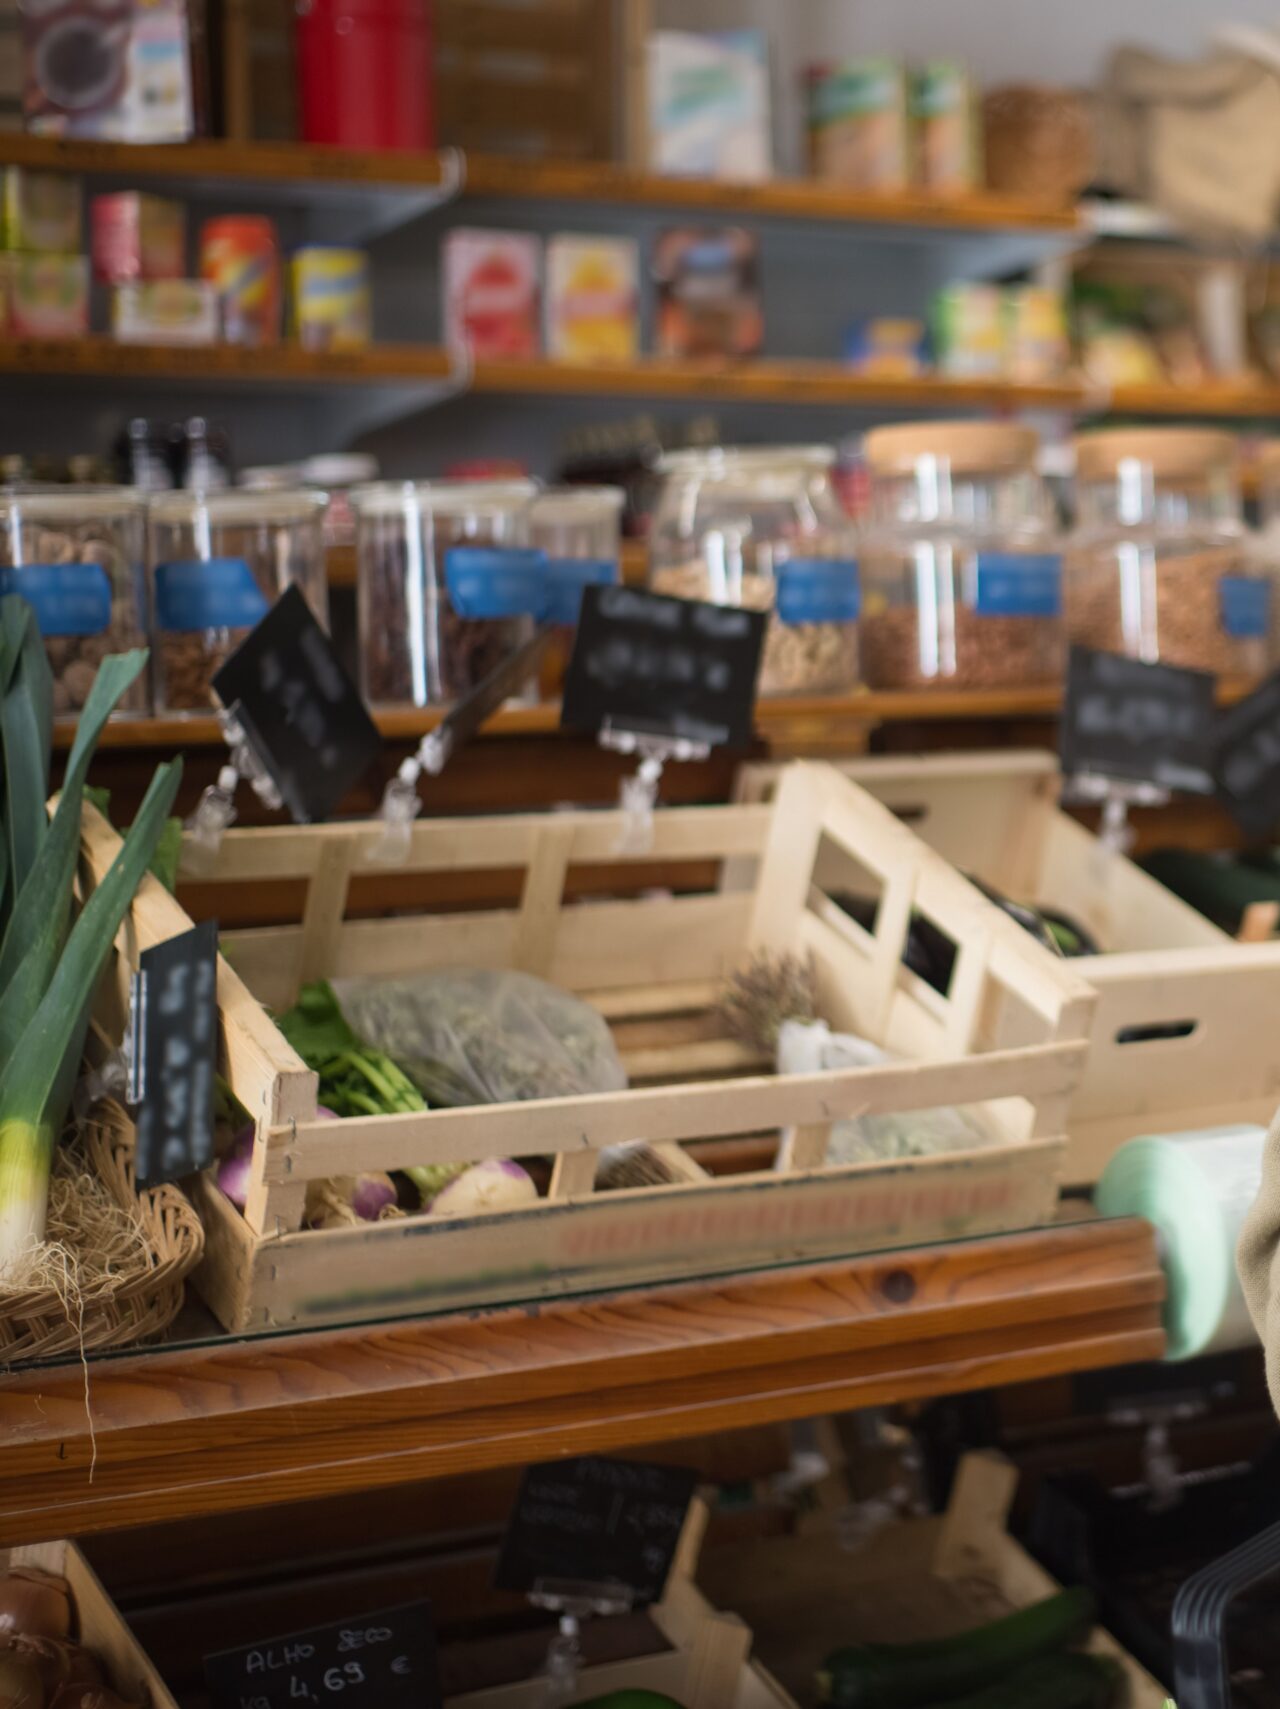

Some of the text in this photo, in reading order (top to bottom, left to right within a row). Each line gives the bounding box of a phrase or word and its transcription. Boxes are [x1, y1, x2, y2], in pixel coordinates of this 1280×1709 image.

[246, 1644, 315, 1674] ALHO
[289, 1661, 366, 1704] 4,69
[390, 1655, 411, 1675] €
